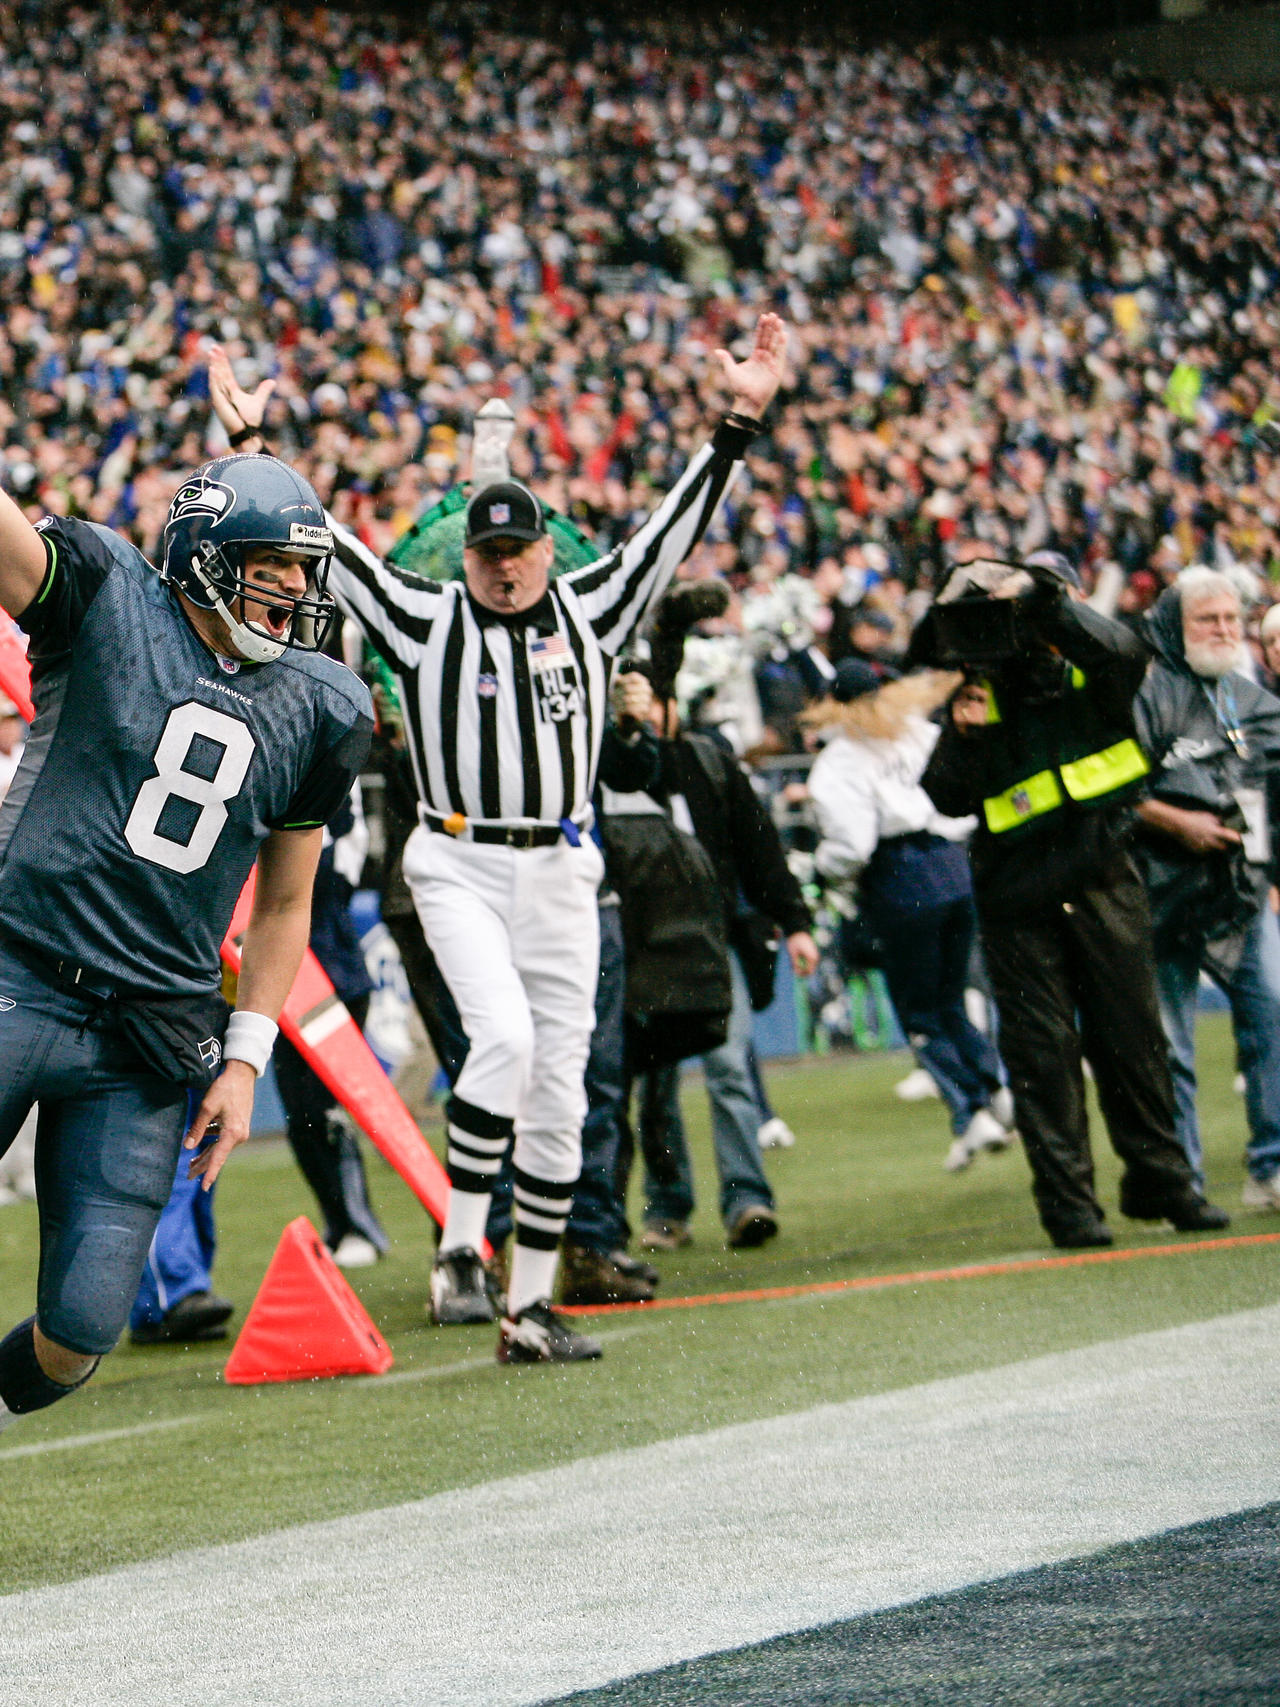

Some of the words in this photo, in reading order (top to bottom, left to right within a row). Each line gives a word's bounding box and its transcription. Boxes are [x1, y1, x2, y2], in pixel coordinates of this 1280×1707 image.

[195, 676, 254, 706] SEAHAWKS
[540, 668, 574, 696] HL
[540, 687, 585, 723] 134
[123, 700, 257, 875] 8
